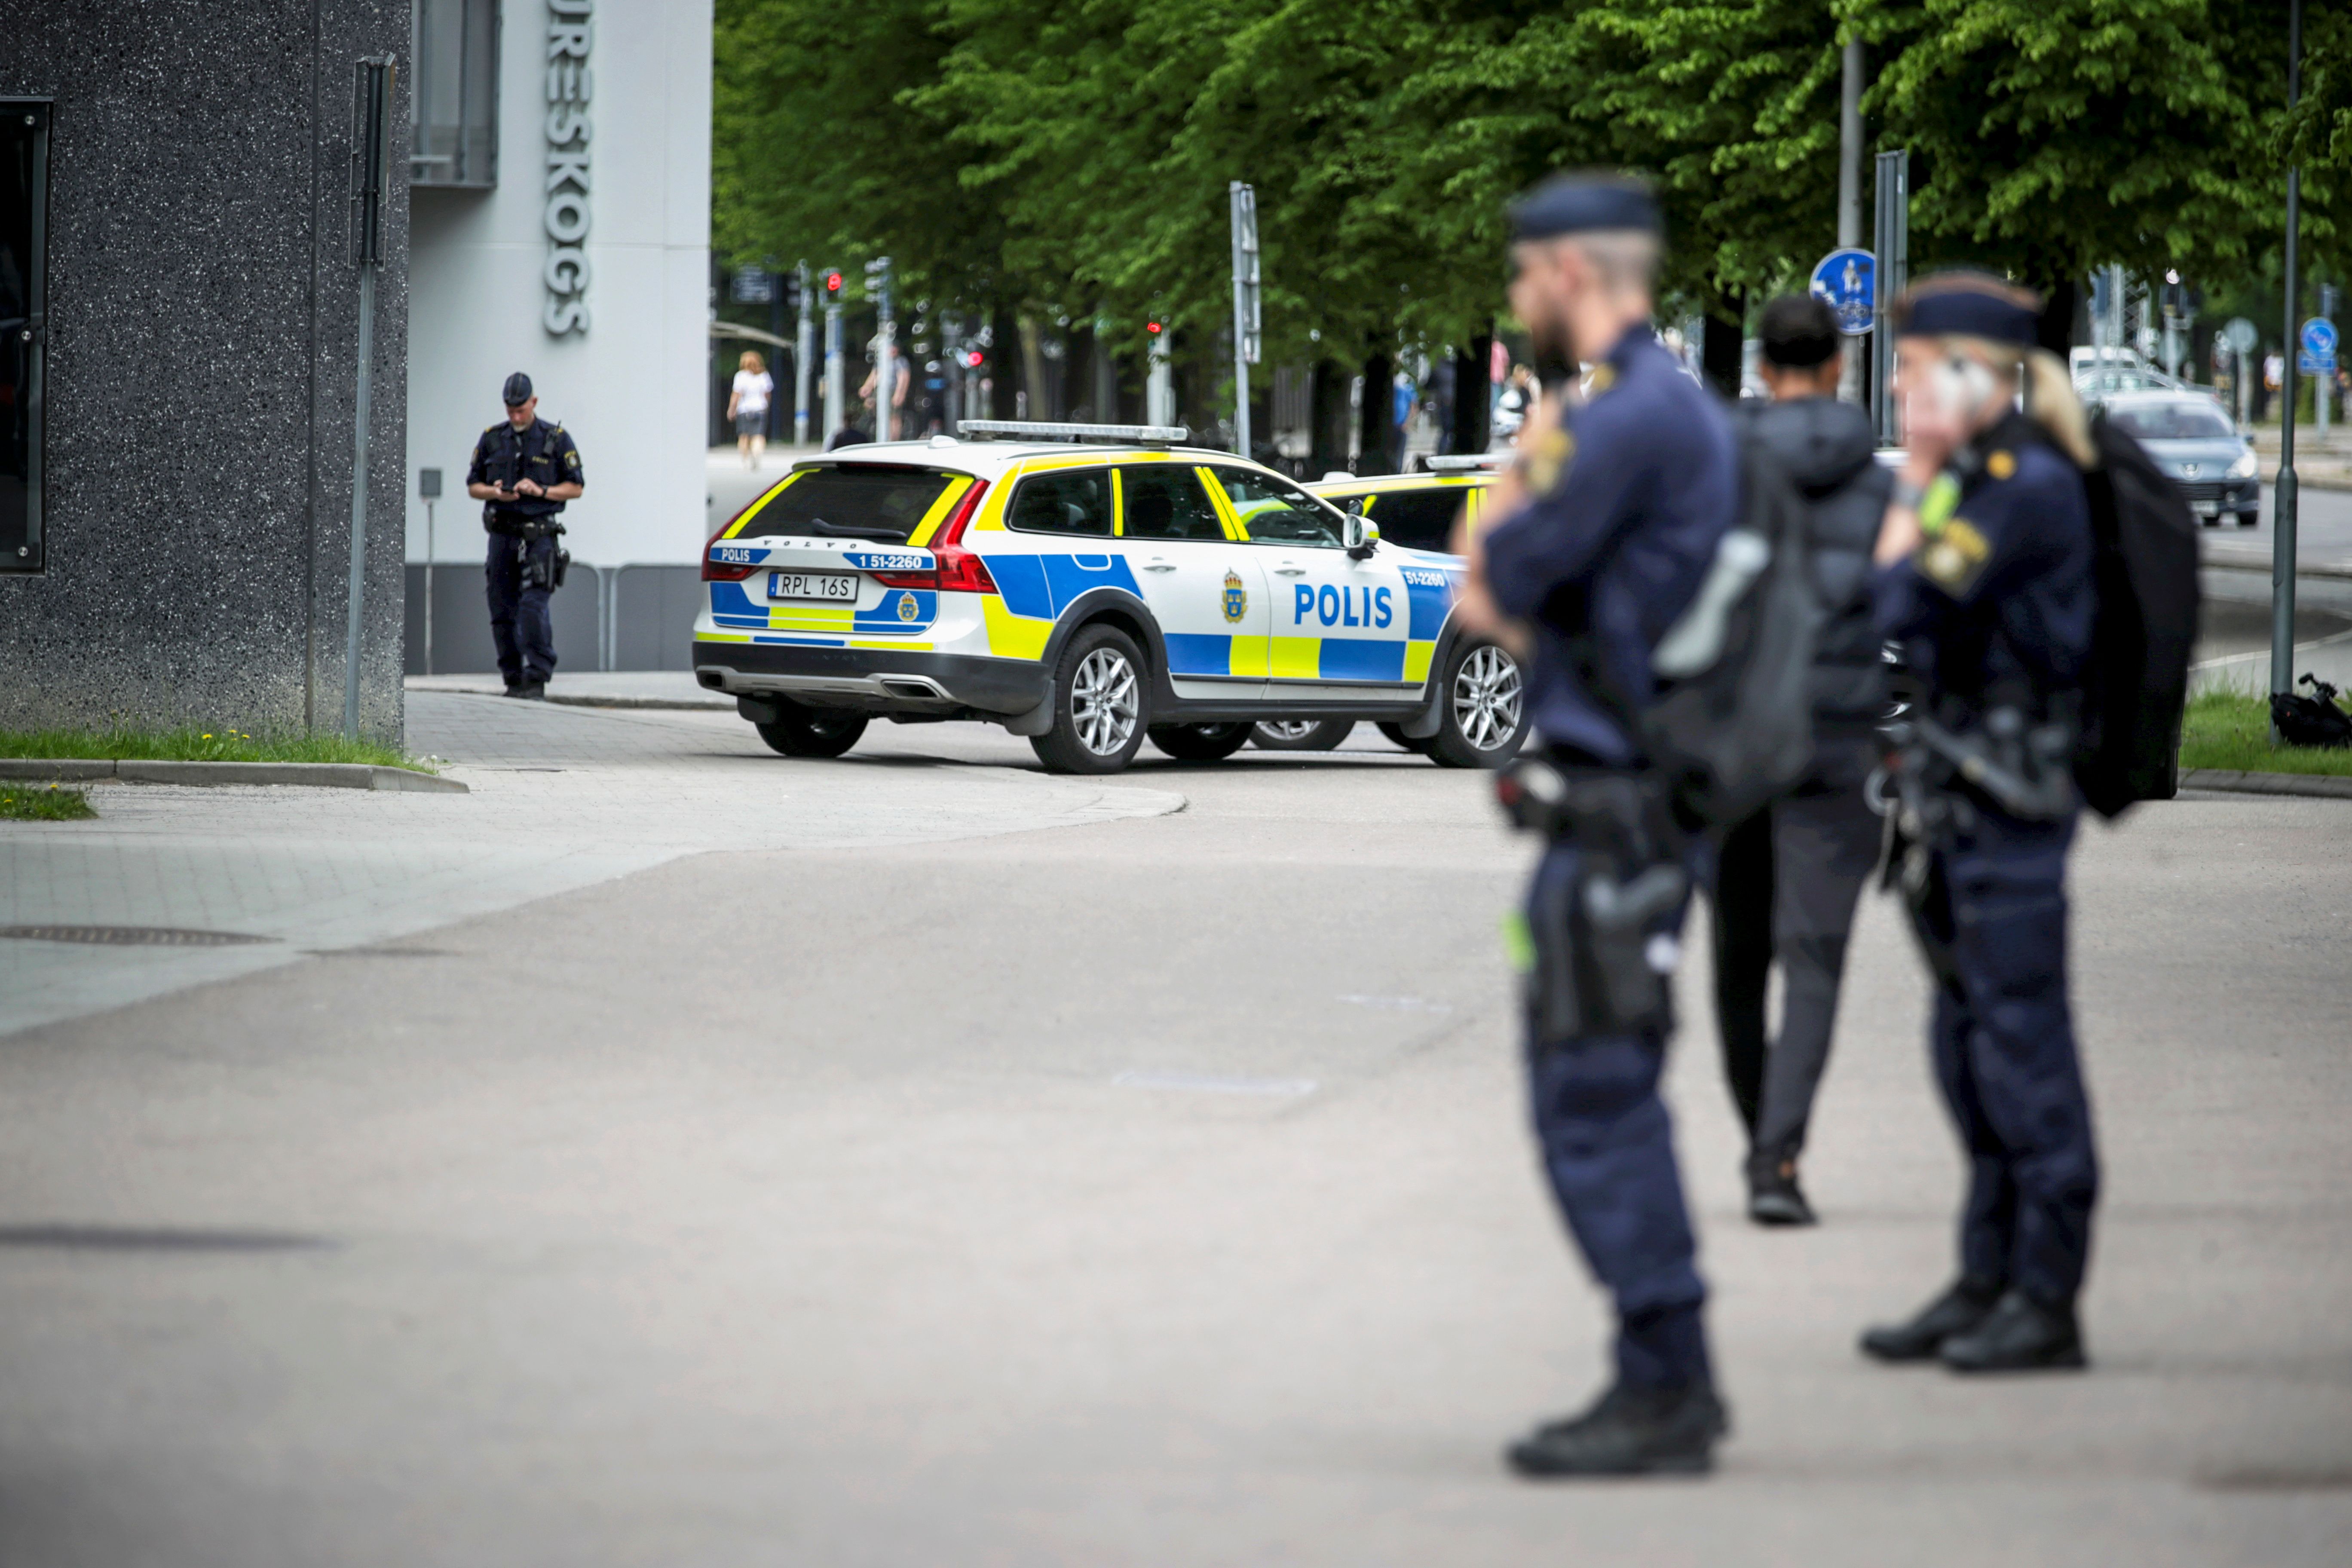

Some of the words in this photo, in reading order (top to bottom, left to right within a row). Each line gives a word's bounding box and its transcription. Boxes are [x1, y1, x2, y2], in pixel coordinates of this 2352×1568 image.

[763, 540, 857, 549] VOLVO
[721, 548, 750, 562] POLIS
[860, 555, 866, 567] 1
[871, 555, 922, 569] 51-2260
[781, 576, 811, 595] RPL
[820, 578, 849, 596] 16S
[1406, 571, 1445, 587] 51-2260
[1294, 584, 1393, 628] POLIS
